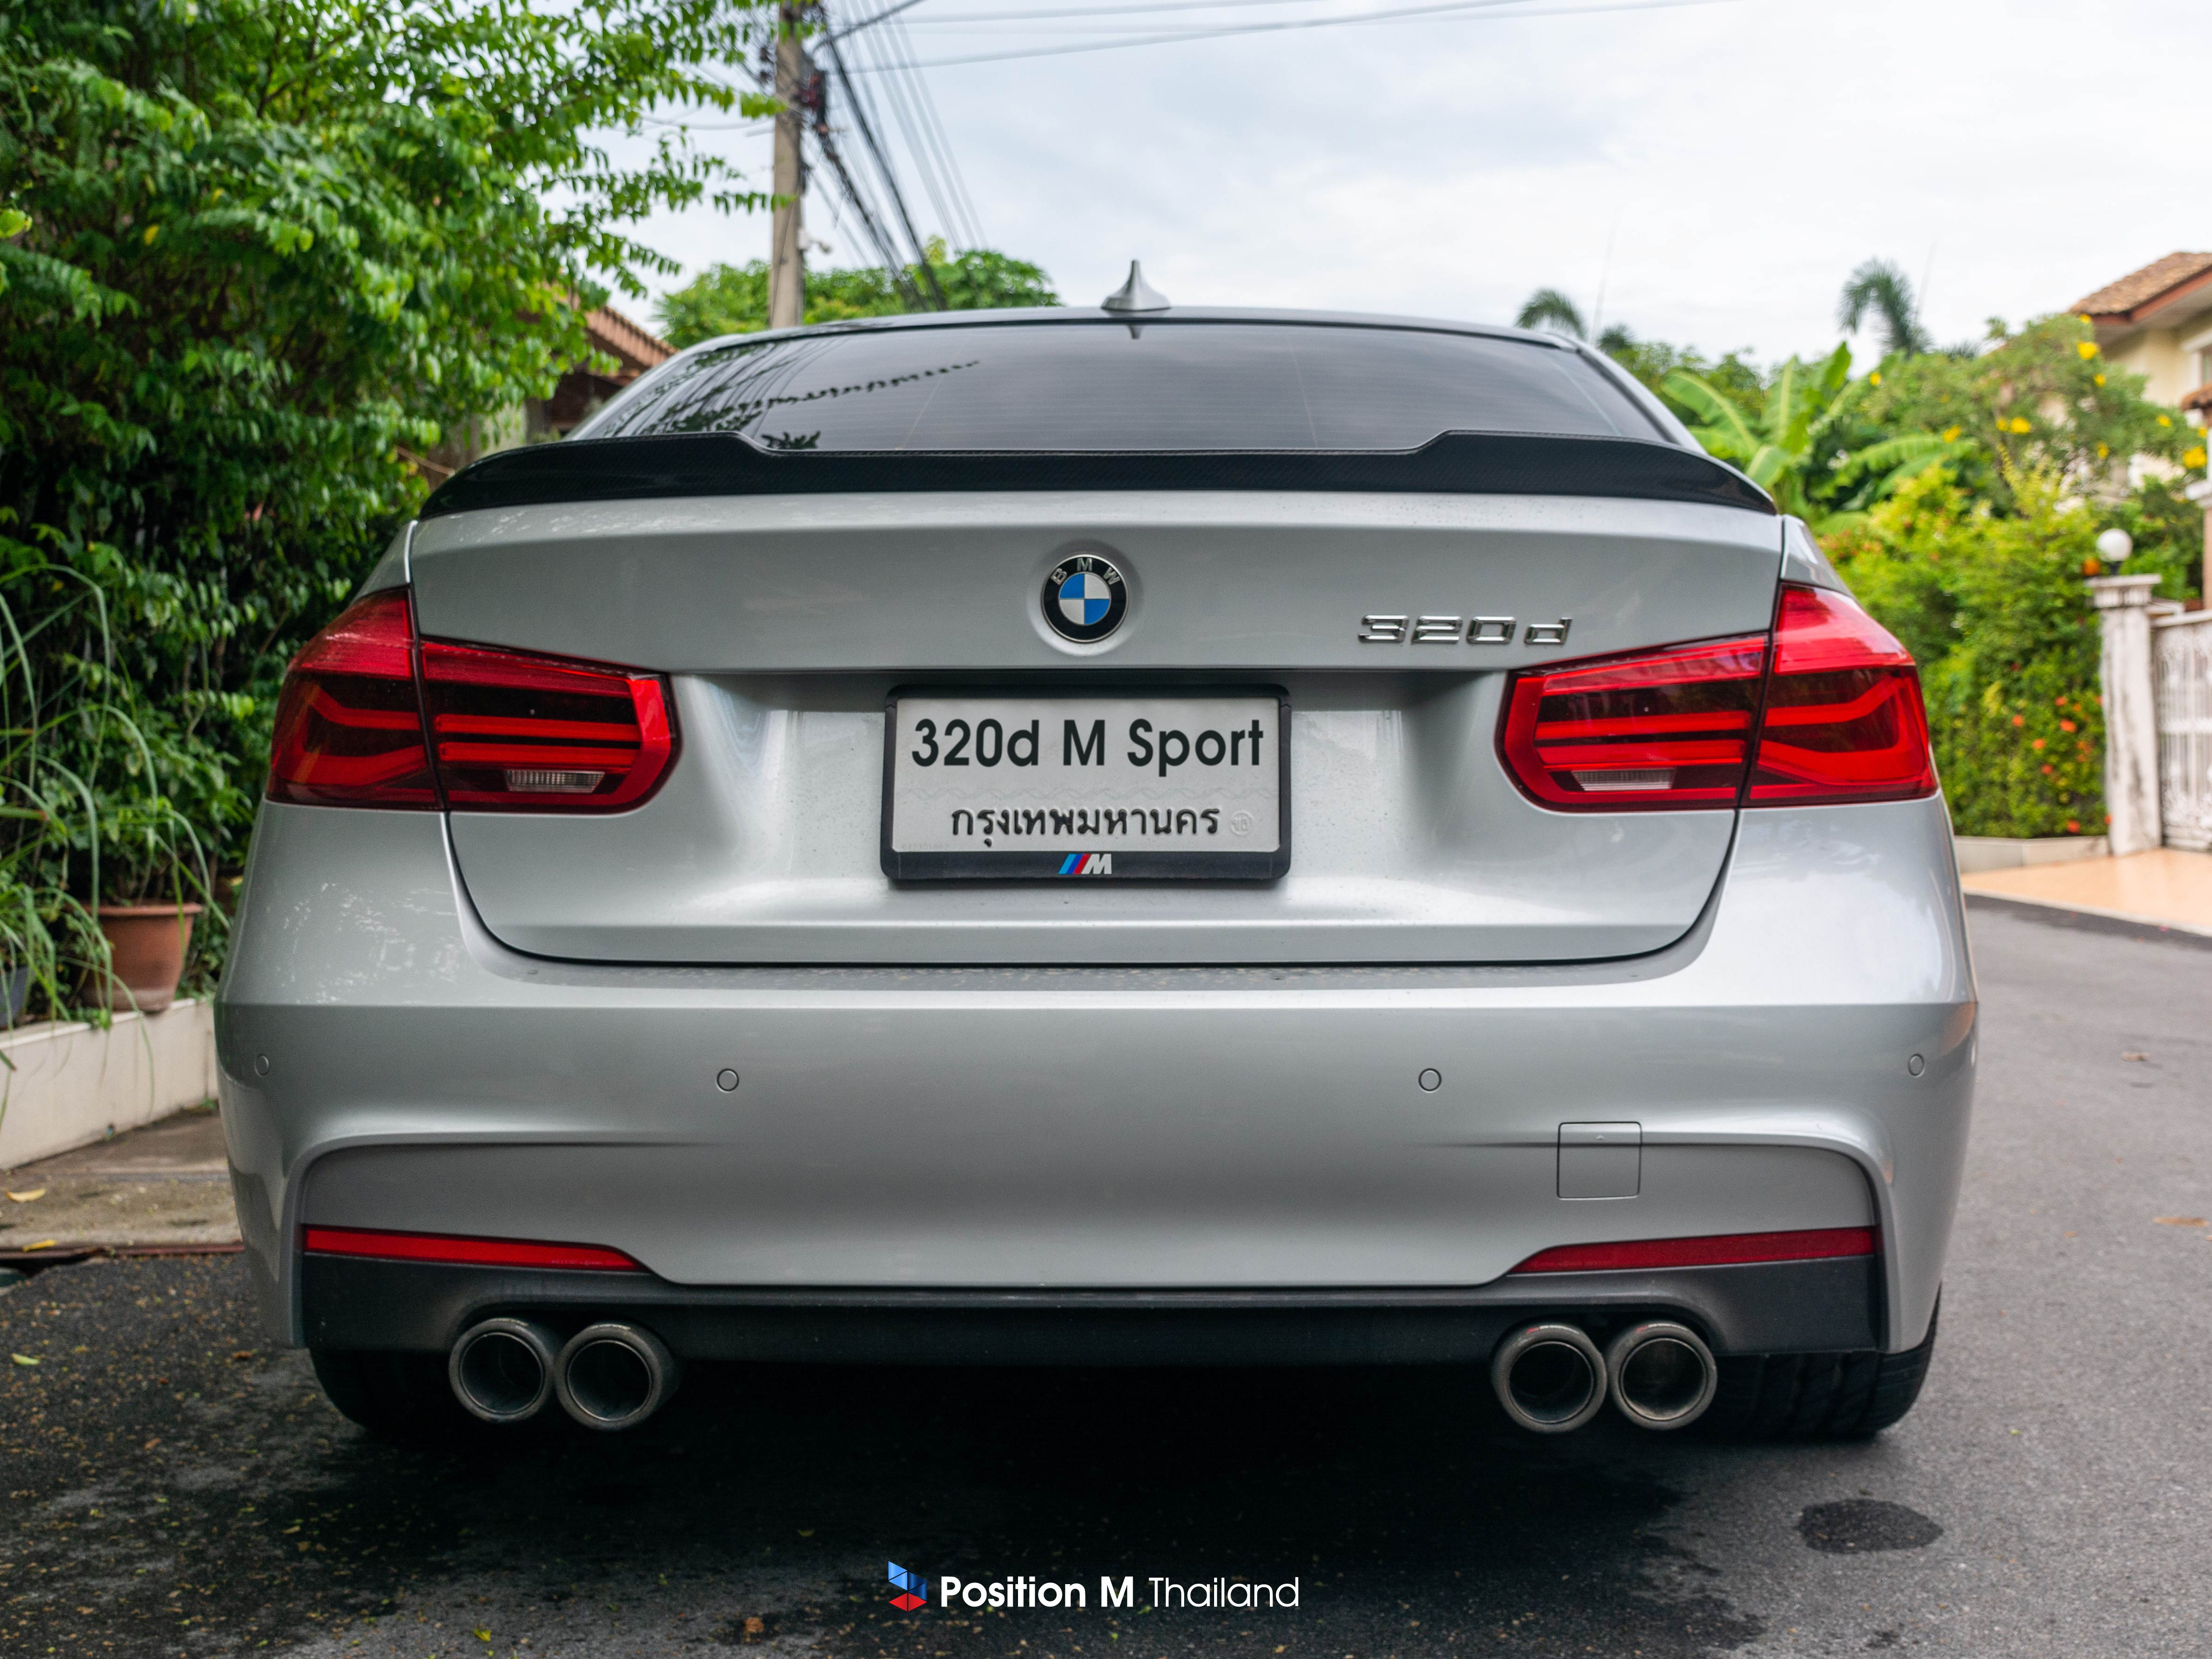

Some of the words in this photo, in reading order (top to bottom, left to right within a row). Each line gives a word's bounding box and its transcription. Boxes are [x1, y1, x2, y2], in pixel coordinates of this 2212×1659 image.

[1050, 557, 1121, 585] BMW
[1358, 614, 1573, 646] 320d
[912, 718, 1040, 767] 320d
[1063, 720, 1105, 766] M
[1127, 718, 1263, 777] Sport
[952, 808, 1220, 848] กรุงเทพมหานคร
[1081, 853, 1112, 875] M
